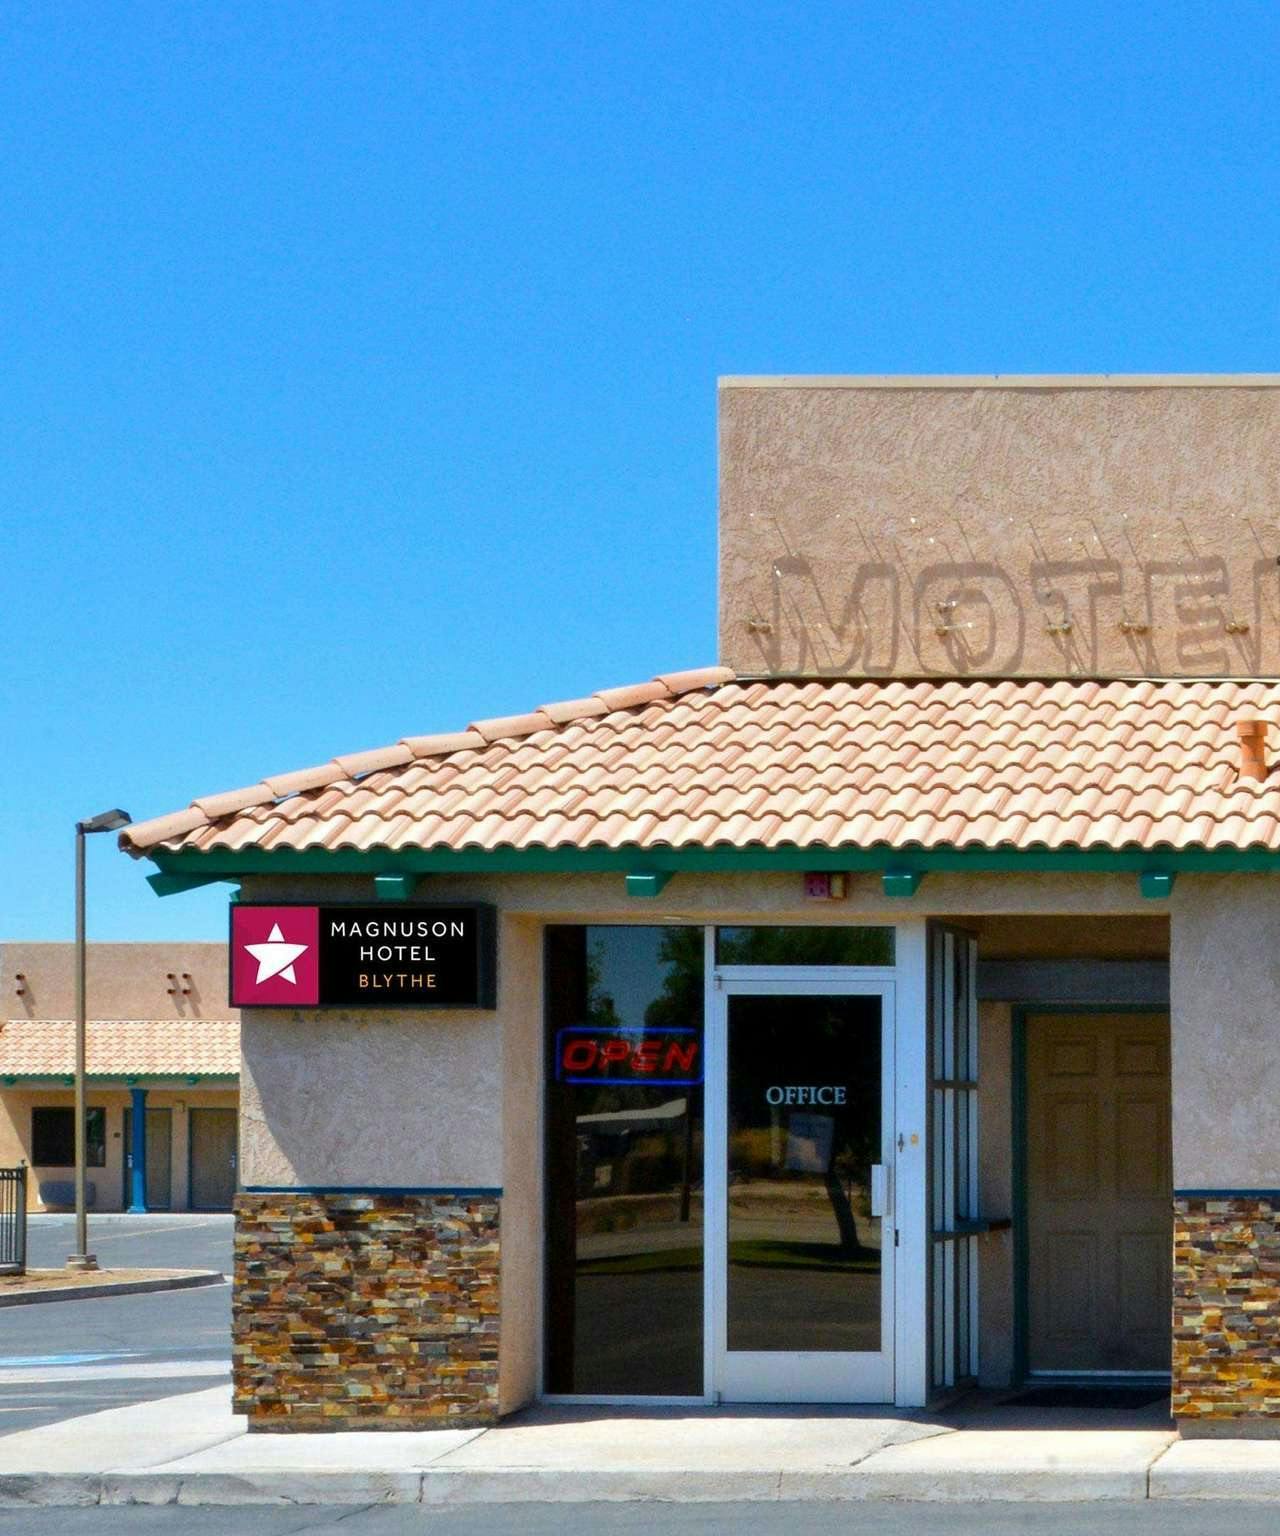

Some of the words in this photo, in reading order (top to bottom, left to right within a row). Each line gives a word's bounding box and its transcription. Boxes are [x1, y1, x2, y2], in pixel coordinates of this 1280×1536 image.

[331, 921, 464, 937] MAGNUSON
[360, 945, 436, 961] HOTEL
[359, 974, 437, 988] BLYTHE
[562, 1039, 699, 1073] OPEN
[766, 1086, 847, 1105] OFFICE
